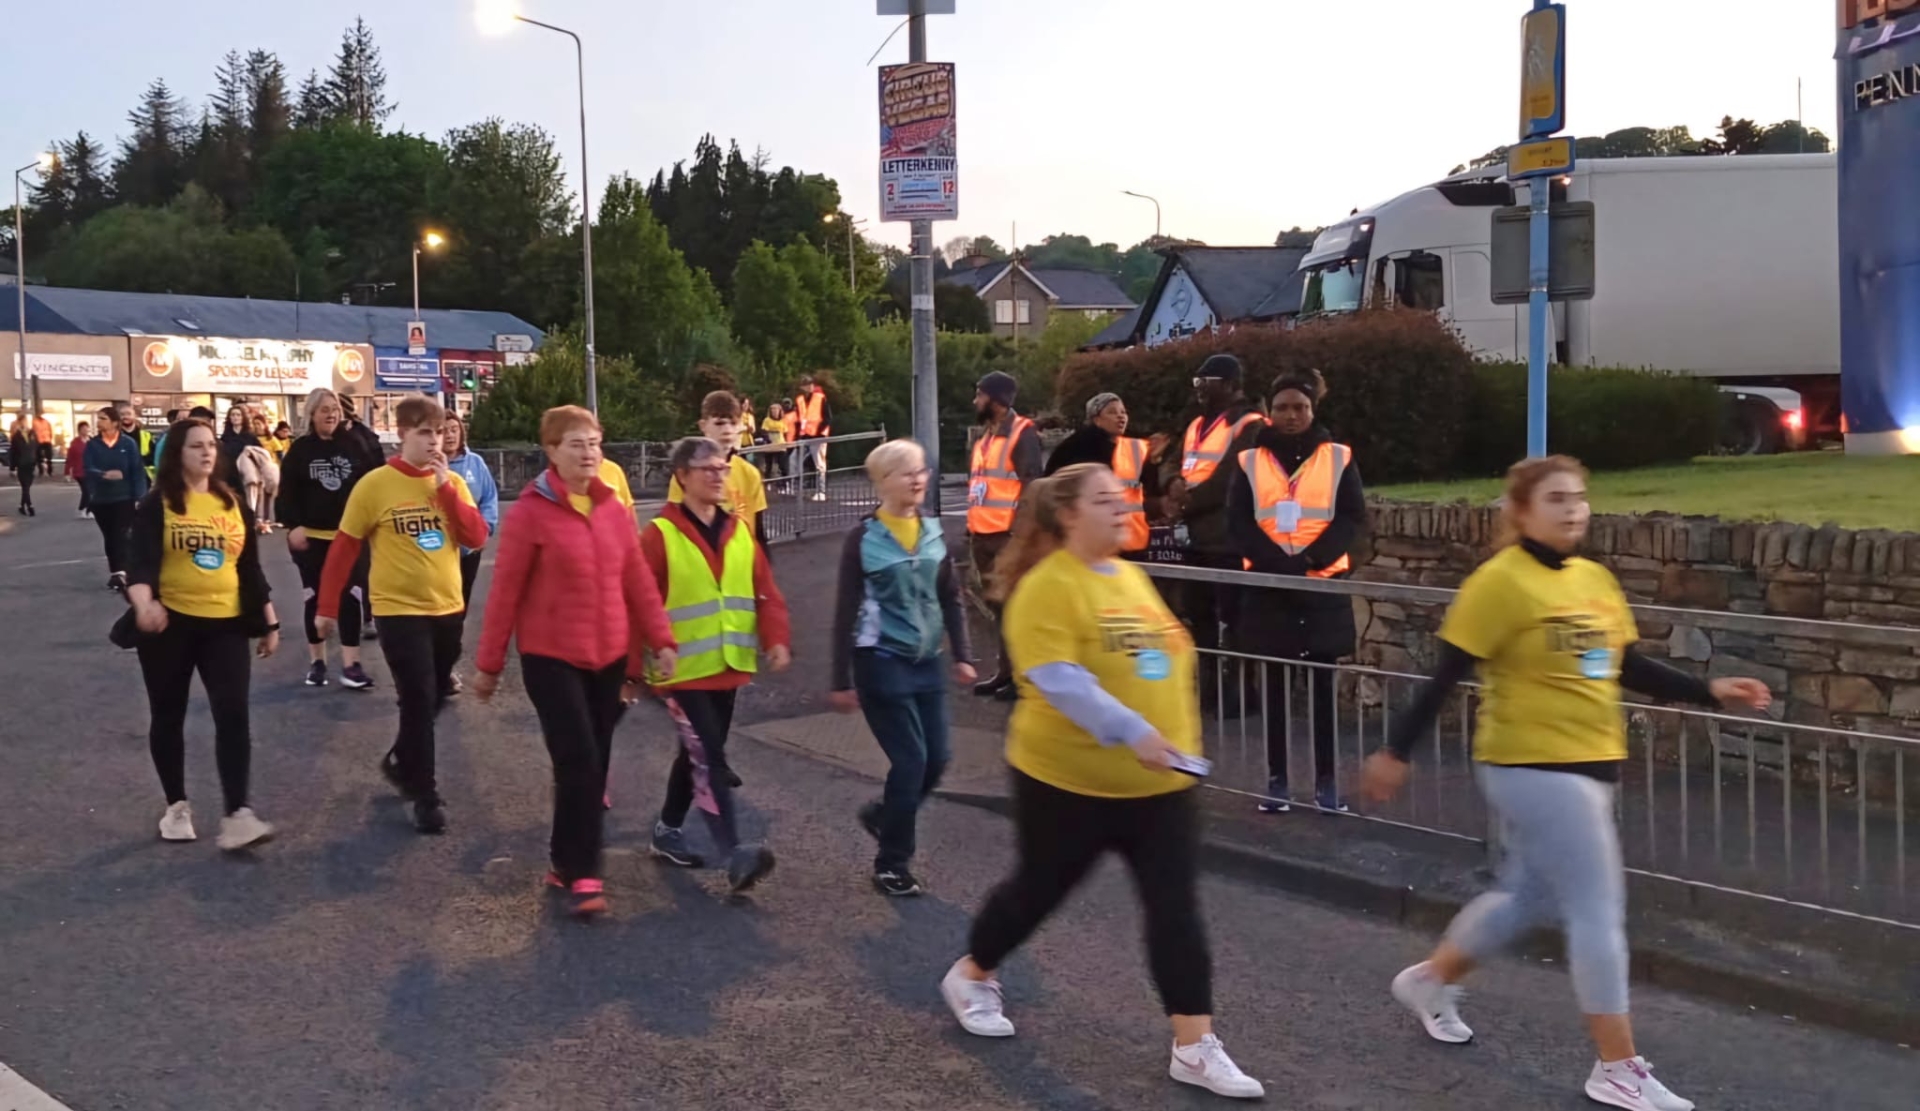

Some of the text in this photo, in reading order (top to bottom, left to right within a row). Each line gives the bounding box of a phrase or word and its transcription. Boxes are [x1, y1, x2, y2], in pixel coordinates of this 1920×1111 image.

[882, 158, 955, 173] LETTERKENNY
[887, 183, 895, 196] 2
[943, 181, 954, 193] 12
[208, 364, 309, 380] SPORTS & LEISURE
[393, 515, 442, 537] light
[172, 531, 225, 553] light
